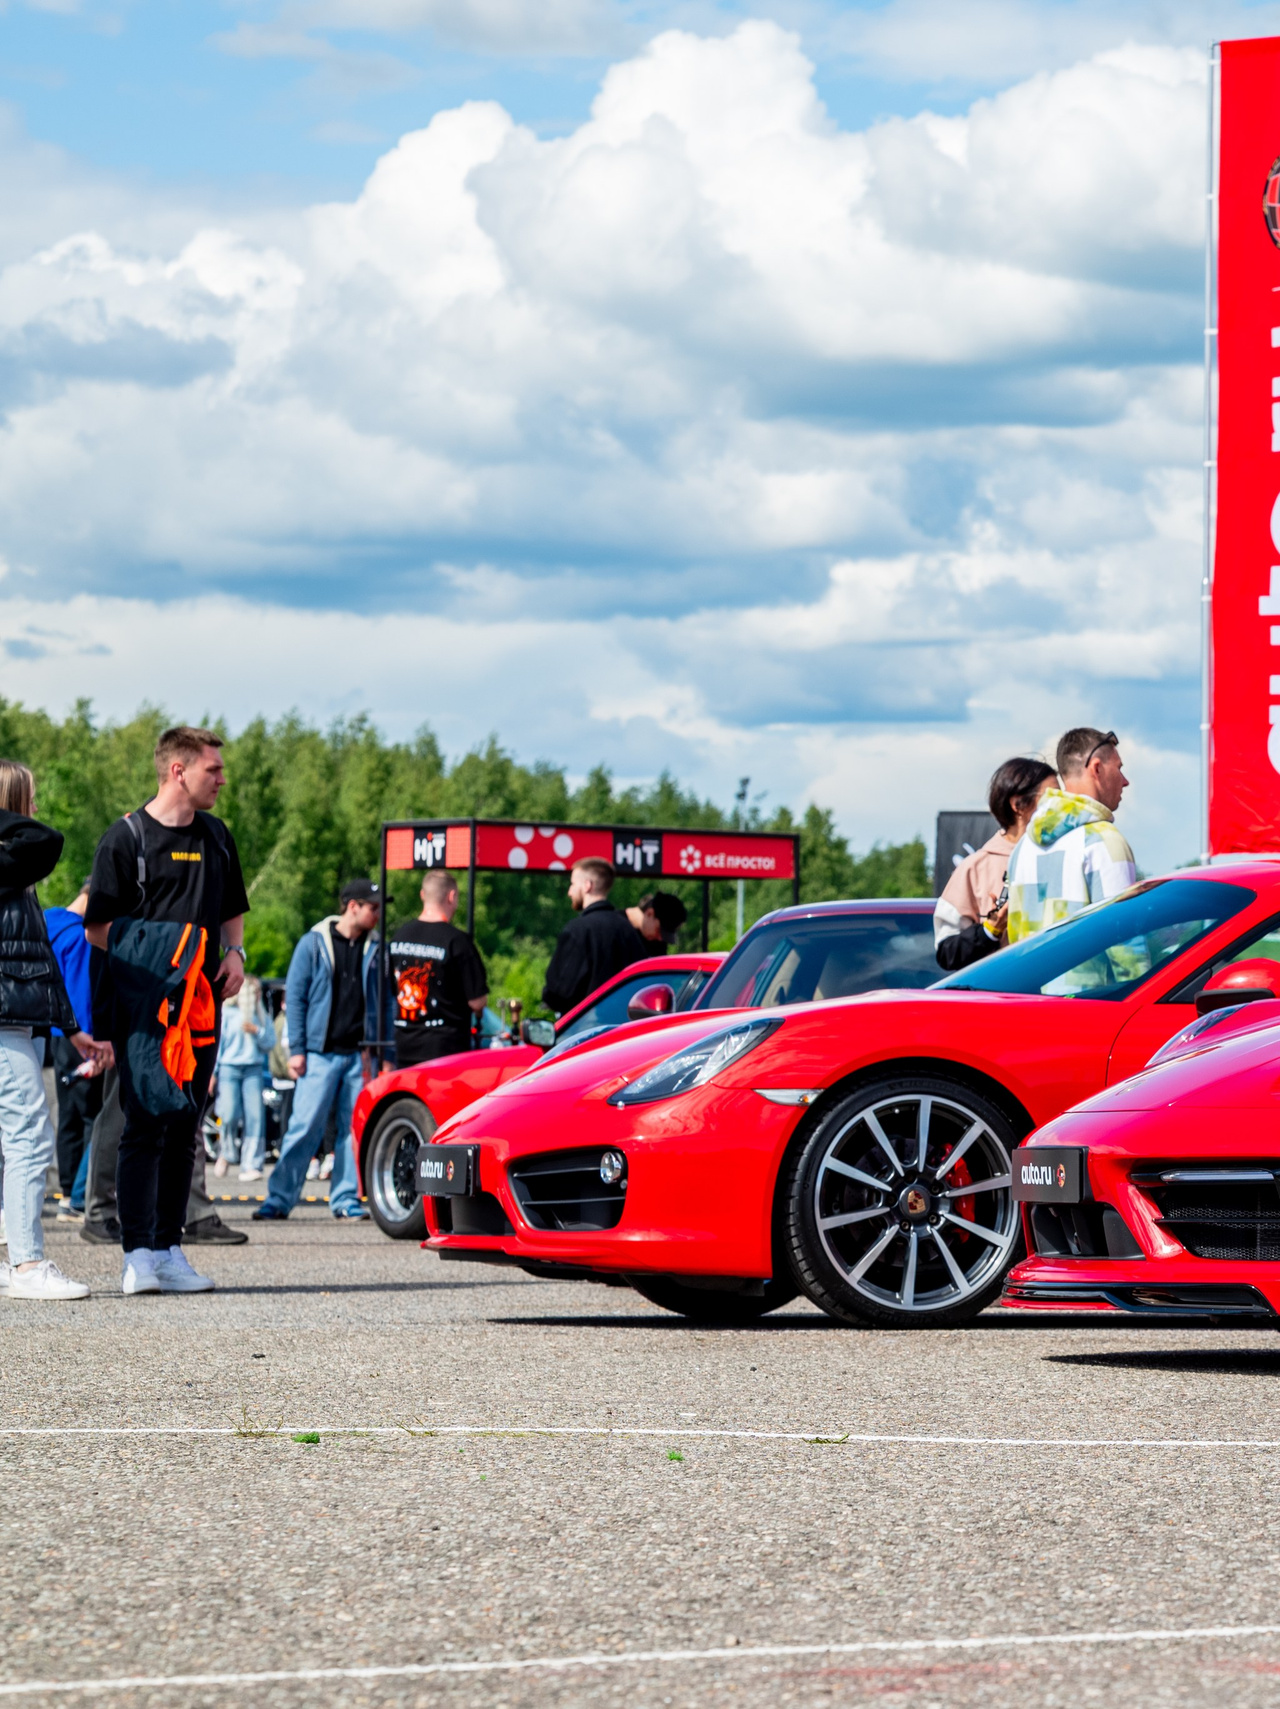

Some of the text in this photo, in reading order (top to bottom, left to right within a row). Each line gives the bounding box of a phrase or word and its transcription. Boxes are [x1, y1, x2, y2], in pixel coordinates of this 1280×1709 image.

[704, 852, 776, 871] ВСЁ ПРОСТО!
[420, 1159, 444, 1179] auto.ru
[1021, 1162, 1053, 1185] auto.ru
